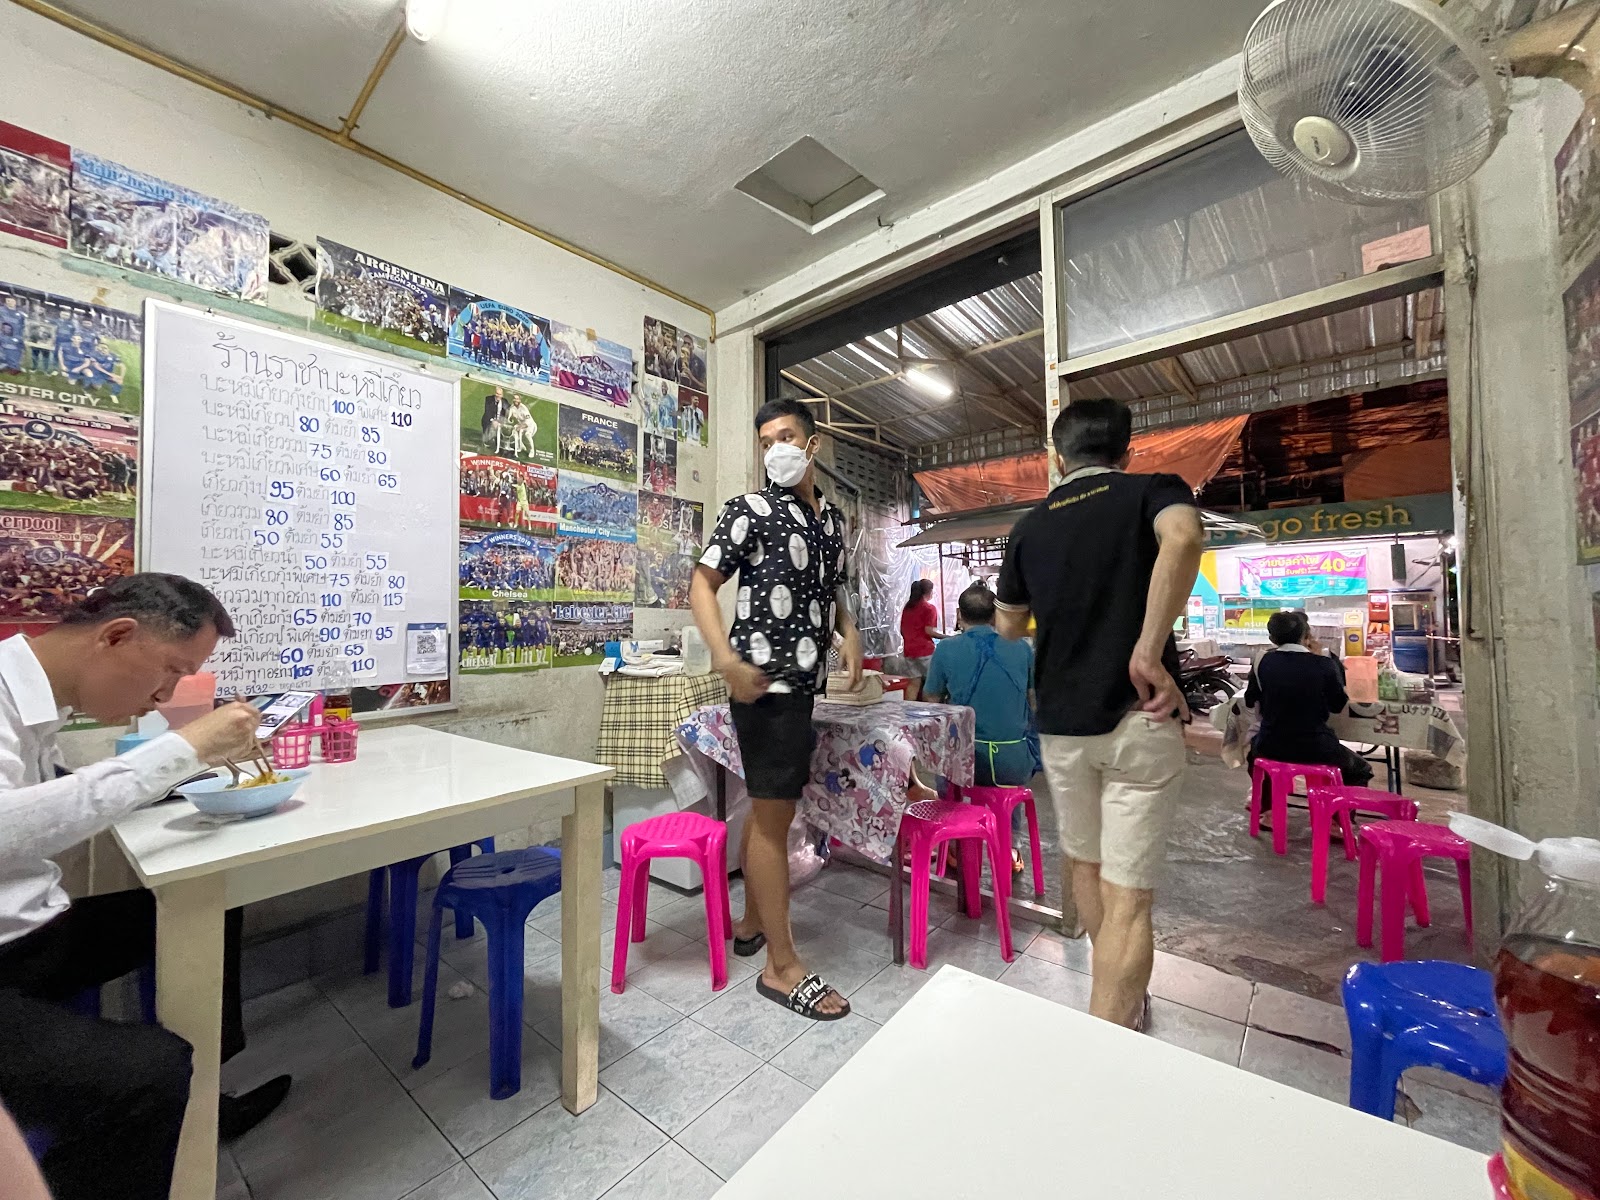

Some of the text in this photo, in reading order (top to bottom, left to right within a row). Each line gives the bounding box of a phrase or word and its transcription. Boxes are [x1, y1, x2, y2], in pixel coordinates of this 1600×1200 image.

[354, 252, 445, 296] ARGENTINA
[506, 361, 541, 377] ITALY
[58, 390, 101, 406] CITY
[332, 399, 355, 415] 100
[390, 411, 412, 428] 110
[582, 412, 618, 429] FRANCE
[299, 415, 319, 433] 80
[361, 426, 381, 444] 85
[309, 442, 332, 459] 75
[367, 450, 387, 465] 80
[470, 459, 504, 468] WINNERS
[320, 467, 341, 482] 60
[377, 473, 397, 489] 65
[269, 480, 295, 500] 95
[330, 490, 356, 506] 100
[0, 516, 62, 532] erpool
[265, 509, 289, 526] 80
[333, 513, 354, 531] 85
[1259, 517, 1303, 543] go
[1310, 504, 1411, 533] fresh
[559, 522, 597, 535] Manchester
[598, 527, 611, 538] City
[254, 529, 280, 546] 50
[320, 533, 344, 549] 55
[489, 533, 518, 544] WINNERS
[304, 555, 327, 570] 50
[366, 554, 387, 570] 55
[1320, 558, 1345, 573] 40
[328, 573, 350, 588] 75
[387, 575, 405, 589] 80
[320, 593, 342, 607] 110
[383, 592, 404, 607] 115
[492, 590, 528, 598] Chelsea
[293, 608, 318, 626] 65
[352, 612, 373, 627] 70
[555, 605, 608, 619] Leicester
[319, 627, 341, 642] 90
[375, 626, 394, 642] 95
[280, 648, 304, 665] 60
[344, 643, 365, 657] 65
[291, 664, 315, 680] 105
[351, 657, 376, 673] 110
